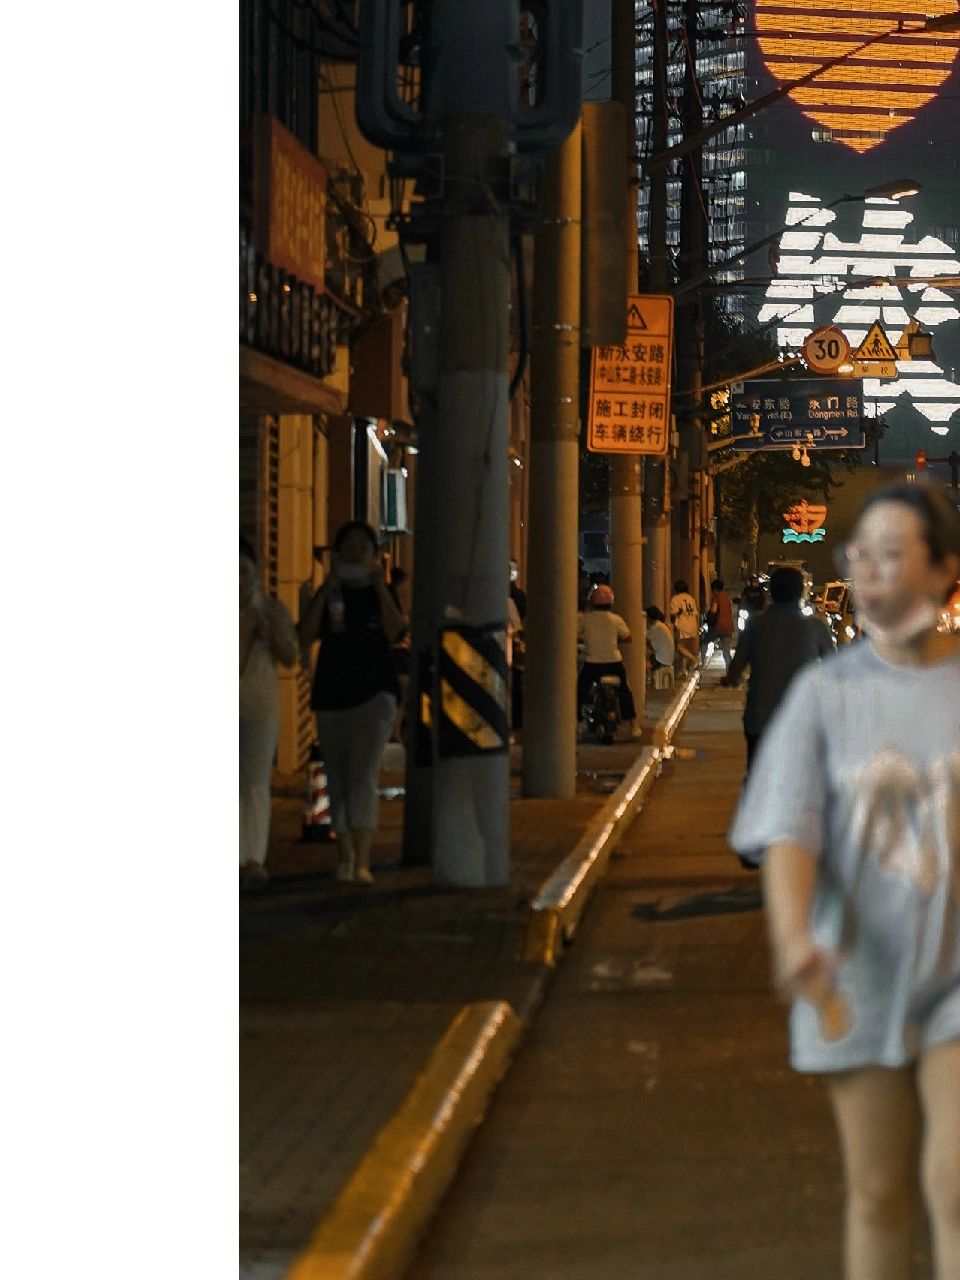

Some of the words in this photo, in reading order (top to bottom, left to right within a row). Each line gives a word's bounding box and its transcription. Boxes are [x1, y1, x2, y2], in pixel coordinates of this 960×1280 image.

[598, 342, 665, 364] 新永安路
[814, 339, 840, 360] 30
[595, 399, 664, 420] 施工封闭
[808, 410, 845, 421] Dongmen
[595, 423, 663, 444] 车辆绕行
